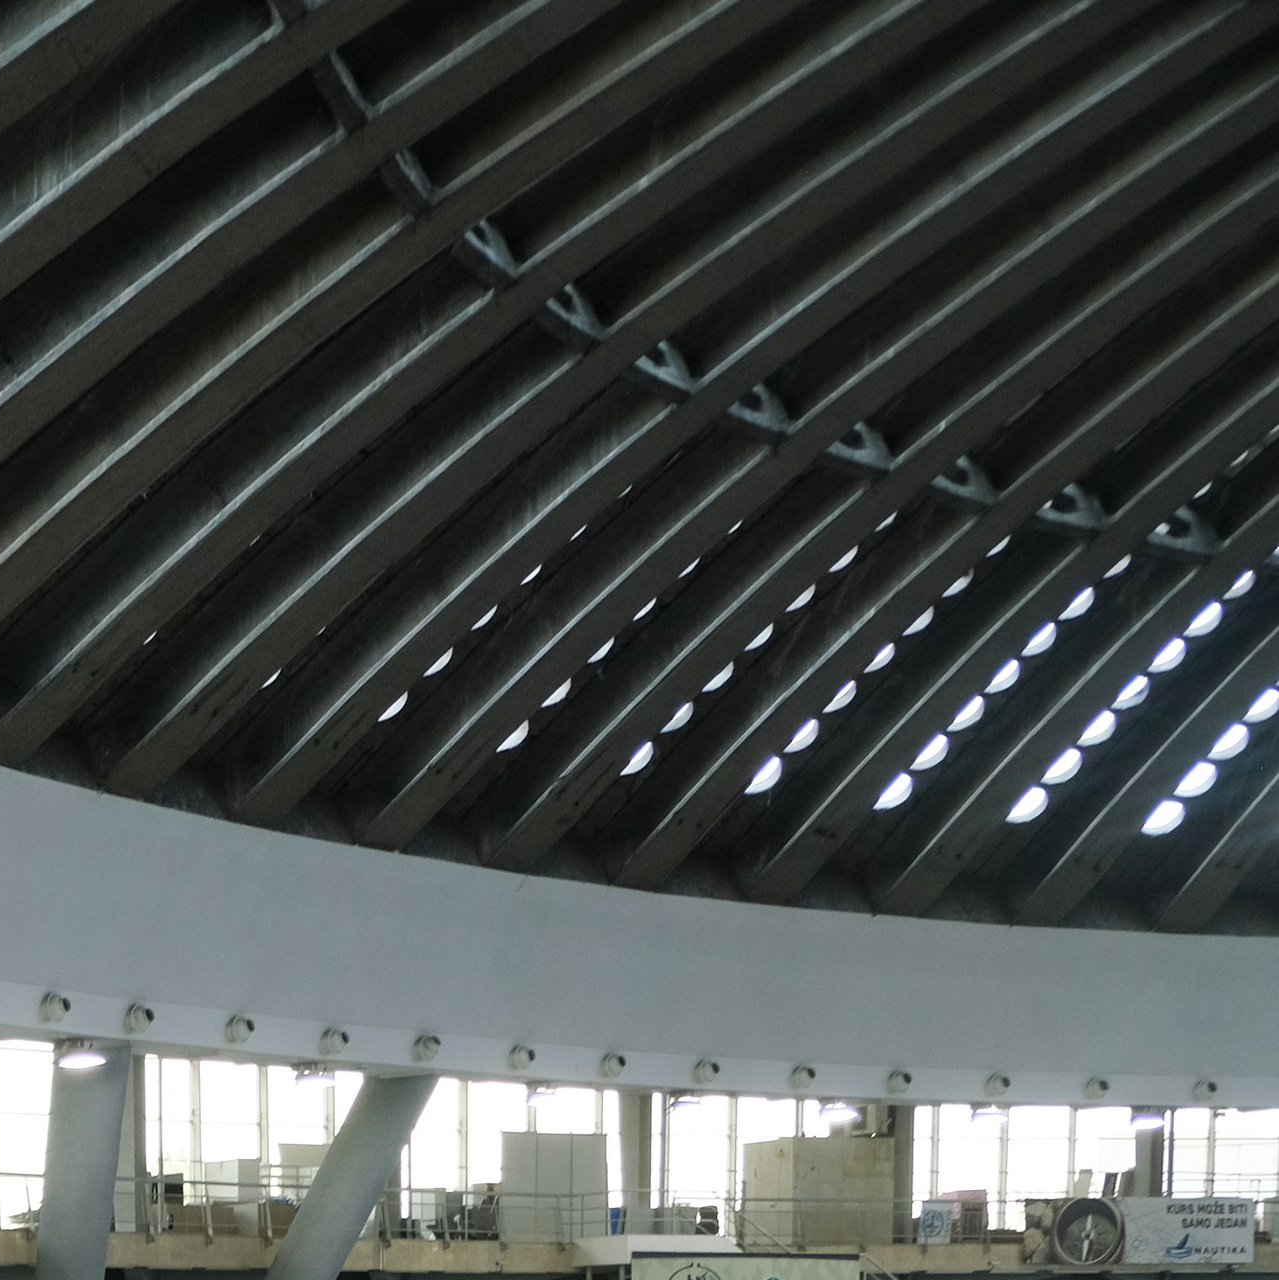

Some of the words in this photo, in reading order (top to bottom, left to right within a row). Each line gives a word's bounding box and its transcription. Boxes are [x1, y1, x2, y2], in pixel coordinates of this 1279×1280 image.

[1166, 1203, 1195, 1215] KURS
[1228, 1204, 1248, 1215] BITI
[1182, 1217, 1210, 1229] SAMO
[1213, 1217, 1248, 1229] JEDAN
